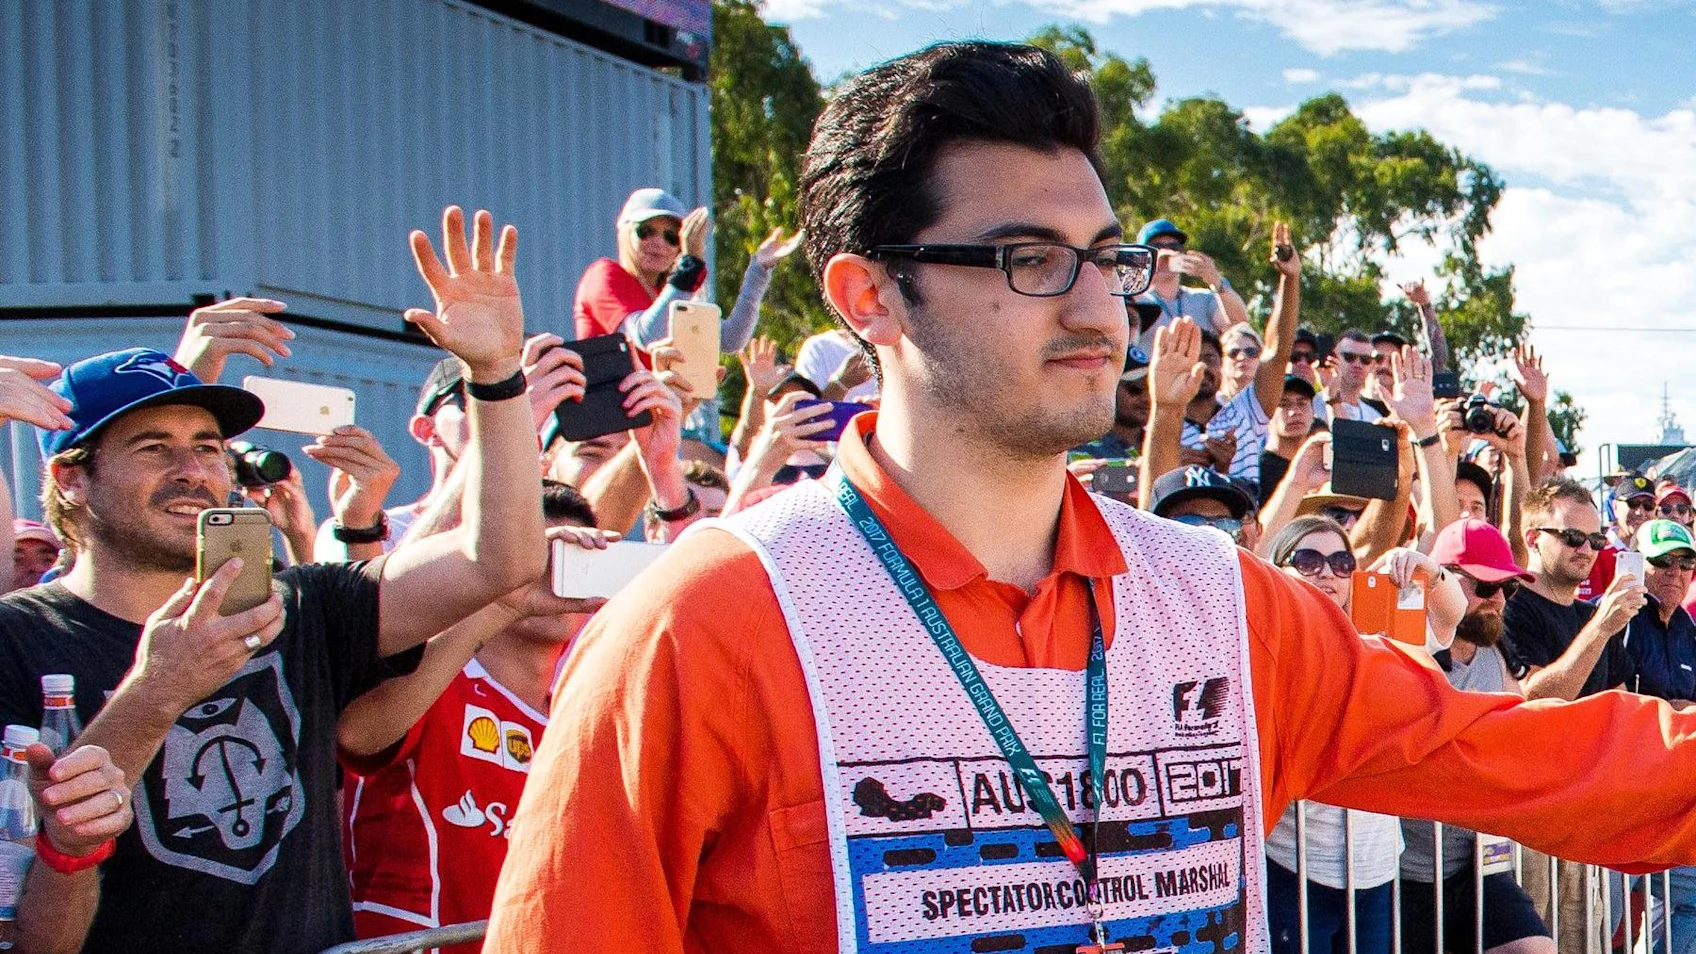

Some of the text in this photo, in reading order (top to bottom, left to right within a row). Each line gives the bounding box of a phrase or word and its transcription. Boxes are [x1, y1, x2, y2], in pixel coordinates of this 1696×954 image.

[859, 516, 887, 544] 2017
[878, 541, 925, 601] FORMULA
[923, 603, 977, 685] AUSTRALIAN
[969, 679, 1005, 728] GRAND
[996, 725, 1022, 758] PRIX
[1093, 698, 1106, 725] FOR
[1173, 676, 1230, 722] F1
[922, 879, 1058, 922] SPECTATOR
[1153, 862, 1231, 900] MARSHAL
